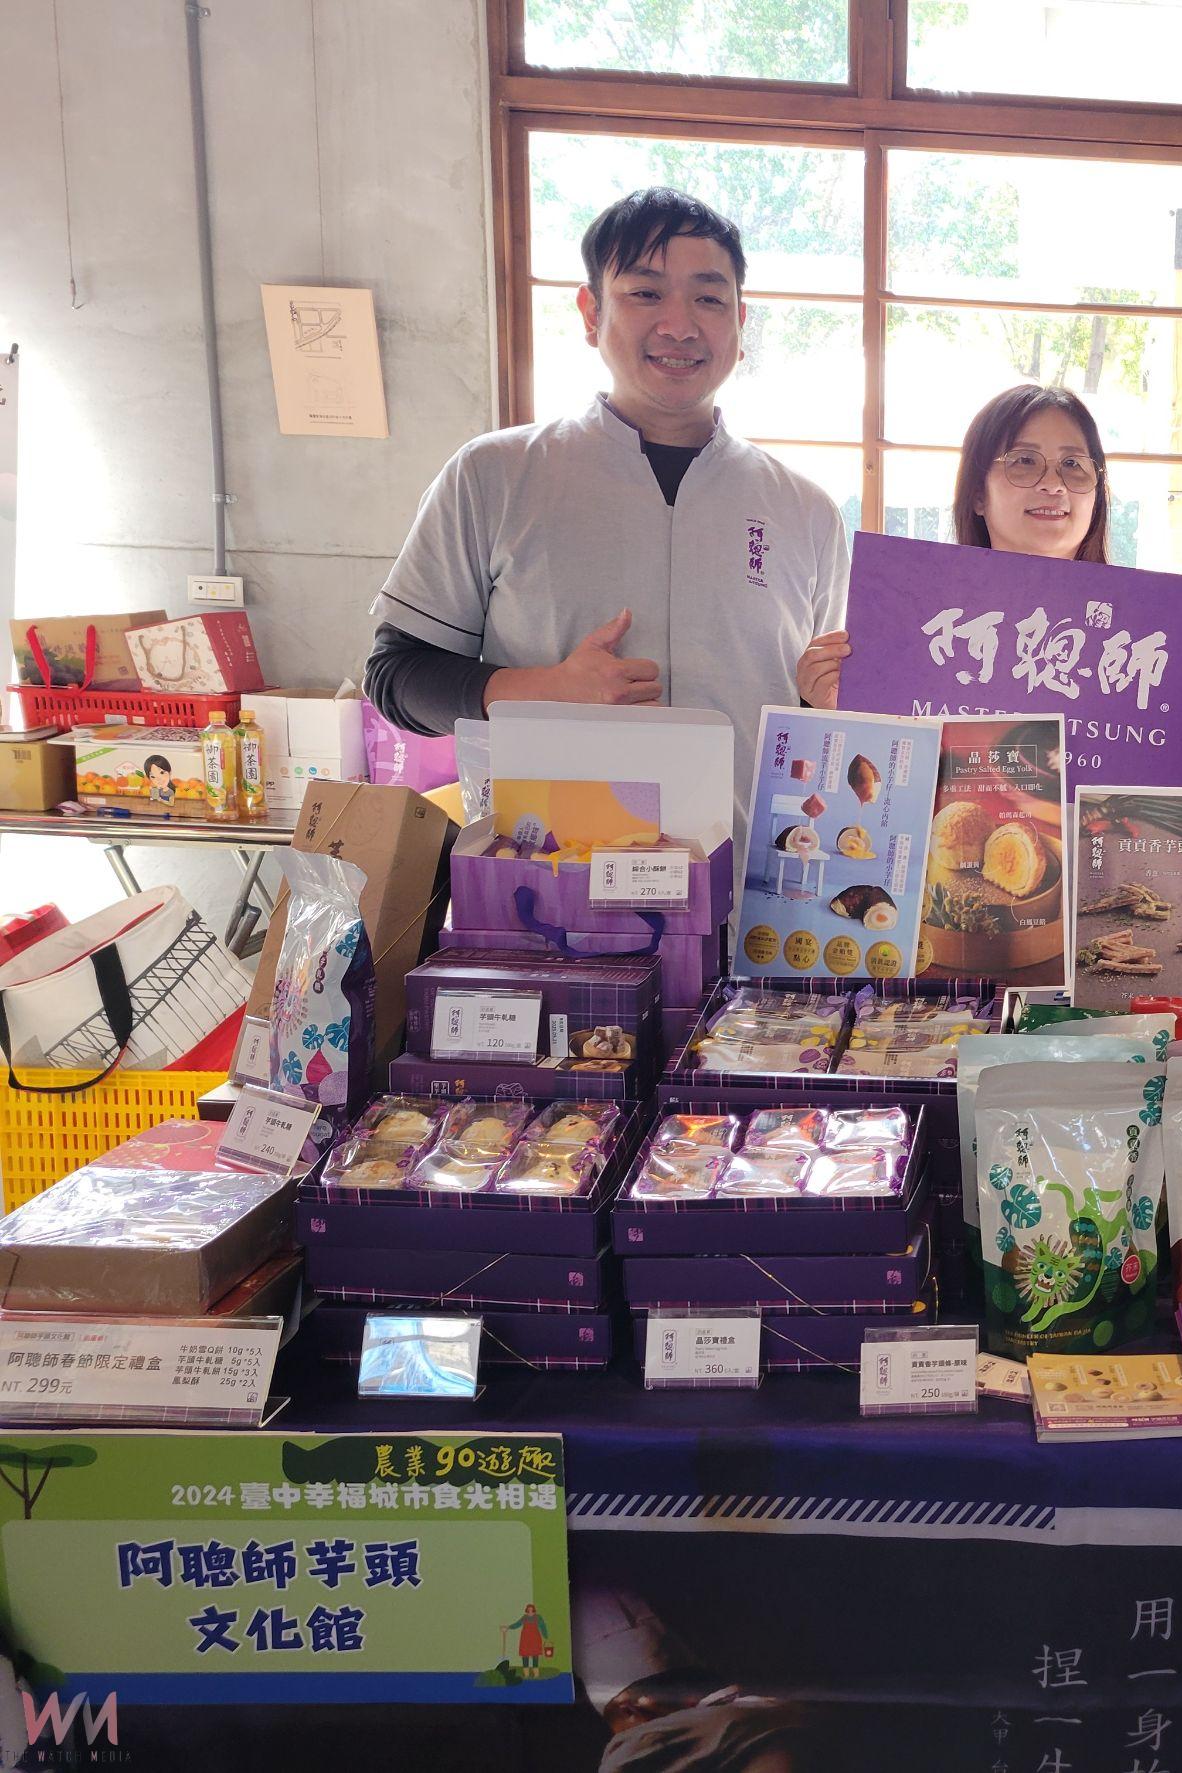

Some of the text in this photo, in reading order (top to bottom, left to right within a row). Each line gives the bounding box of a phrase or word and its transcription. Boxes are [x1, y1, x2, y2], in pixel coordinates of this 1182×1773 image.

[748, 527, 763, 574] 阿聰師
[920, 607, 1168, 710] 阿聰師
[242, 742, 259, 781] 御茶園
[393, 741, 407, 777] 阿聰師
[773, 732, 790, 770] 阿聰師
[205, 742, 222, 785] 御茶園
[956, 764, 1033, 775] Pastry Salted Egg Yolk
[306, 801, 323, 842] 阿聰師
[1091, 836, 1104, 871] 阿聰師
[606, 863, 614, 886] 阿聰師
[640, 887, 657, 896] 270
[794, 936, 813, 947] 國宴
[792, 953, 811, 963] 點心
[486, 1038, 504, 1048] 120
[260, 1143, 275, 1155] 240
[1014, 1127, 1030, 1168] 阿聰師
[228, 1346, 244, 1356] 10g
[664, 1332, 674, 1362] 阿聰師
[7, 1351, 164, 1372] 阿聰師春節限定禮盒
[175, 1365, 221, 1377] 芋頭牛軋餅
[223, 1367, 239, 1377] 15g
[177, 1355, 224, 1366] 芋頭牛軋糖
[231, 1357, 242, 1366] 5g
[705, 1364, 724, 1374] 360
[879, 1356, 889, 1387] 阿聰師
[1, 1380, 23, 1393] NT.
[171, 1375, 200, 1386] 鳳梨酥
[220, 1377, 236, 1388] 25g
[921, 1388, 941, 1398] 250
[116, 1538, 424, 1591] 阿聰師芋頭
[187, 1604, 367, 1654] 文化館
